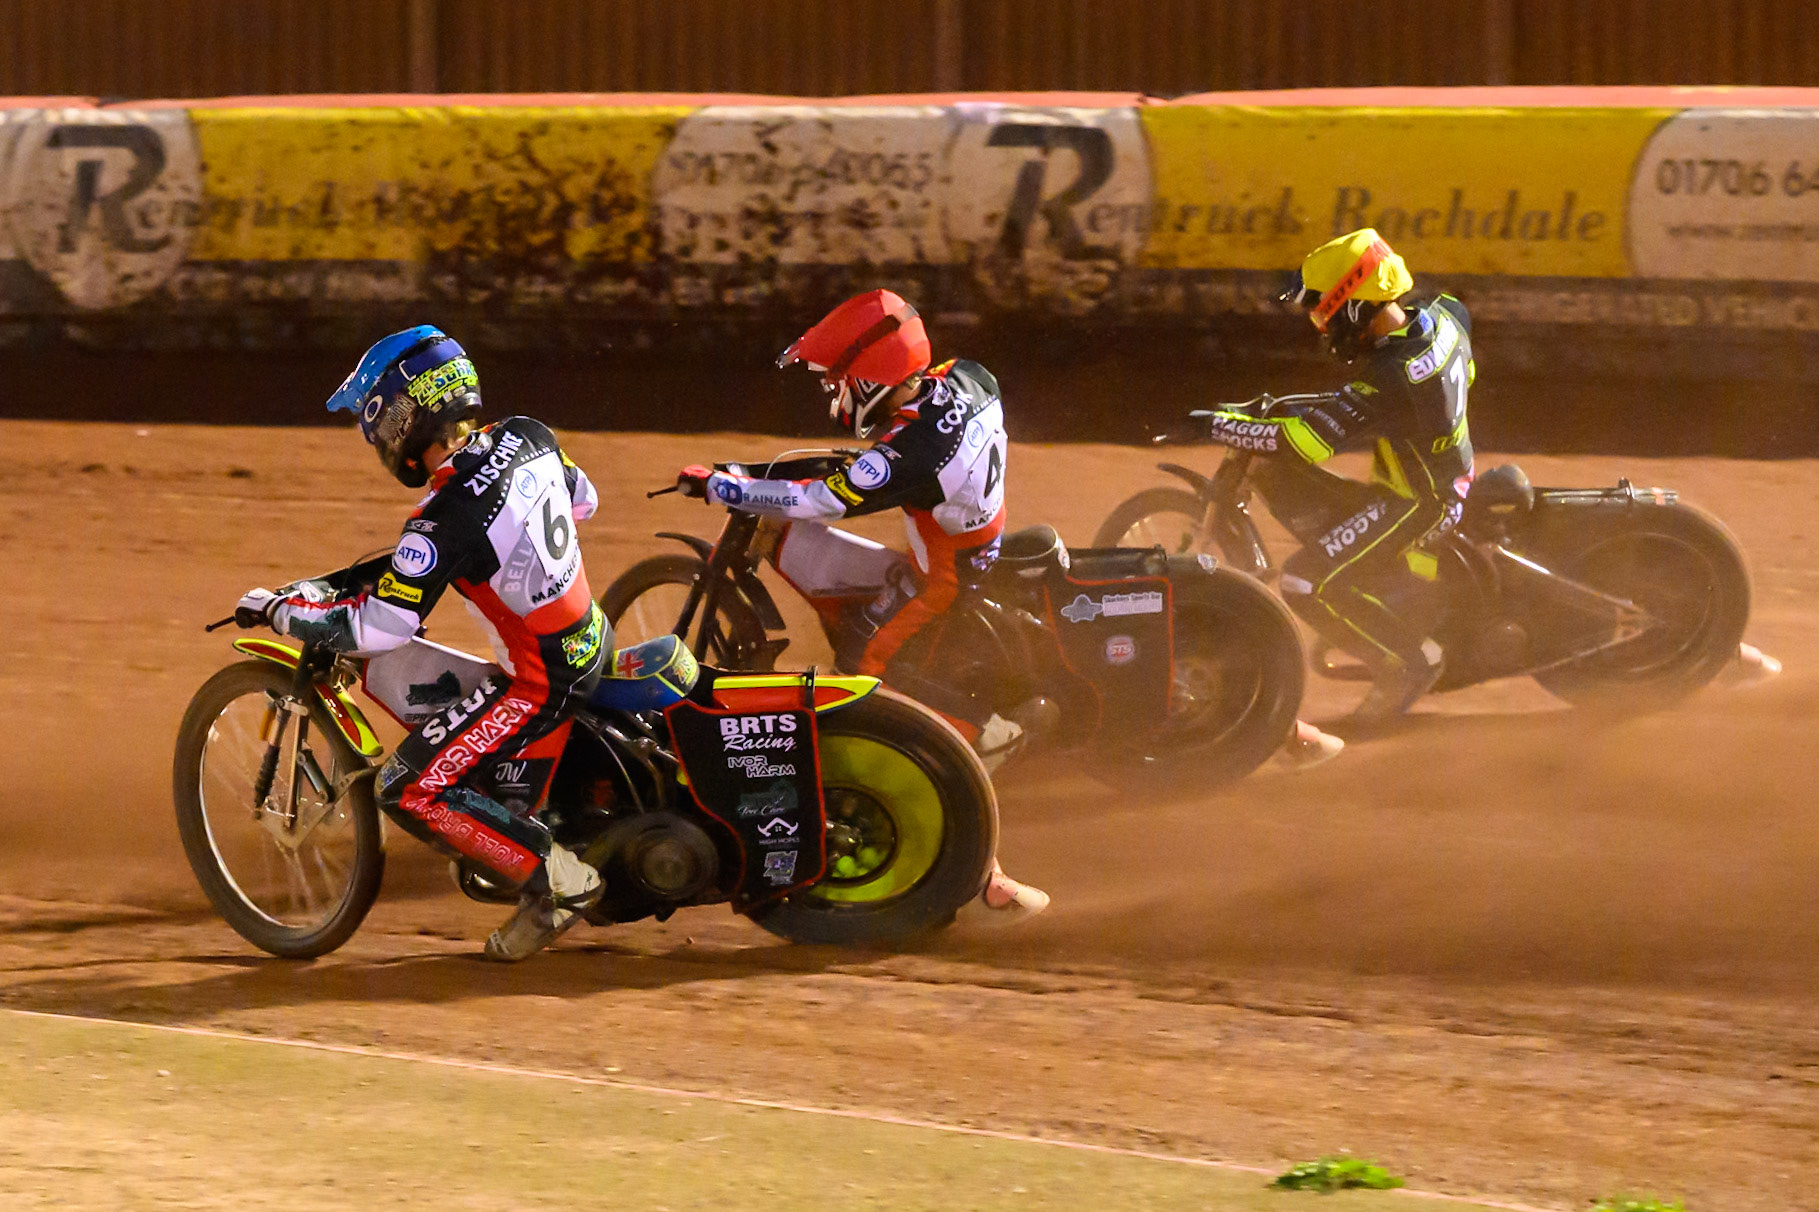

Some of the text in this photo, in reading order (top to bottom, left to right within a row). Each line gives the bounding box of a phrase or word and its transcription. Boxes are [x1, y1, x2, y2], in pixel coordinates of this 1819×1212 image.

[1656, 158, 1772, 196] 01706
[936, 388, 973, 434] COOK
[464, 431, 523, 496] ZISCHKE
[857, 458, 881, 480] ATPI
[983, 443, 1001, 499] 4
[542, 497, 569, 560] 6
[398, 546, 426, 564] ATPI
[379, 577, 420, 601] Rentruck
[463, 697, 533, 754] HARM
[720, 714, 797, 736] BRTS
[722, 734, 797, 751] Racing
[495, 761, 527, 782] JW
[727, 755, 767, 768] IVOR
[746, 765, 796, 778] HARM
[475, 832, 524, 866] NOEL
